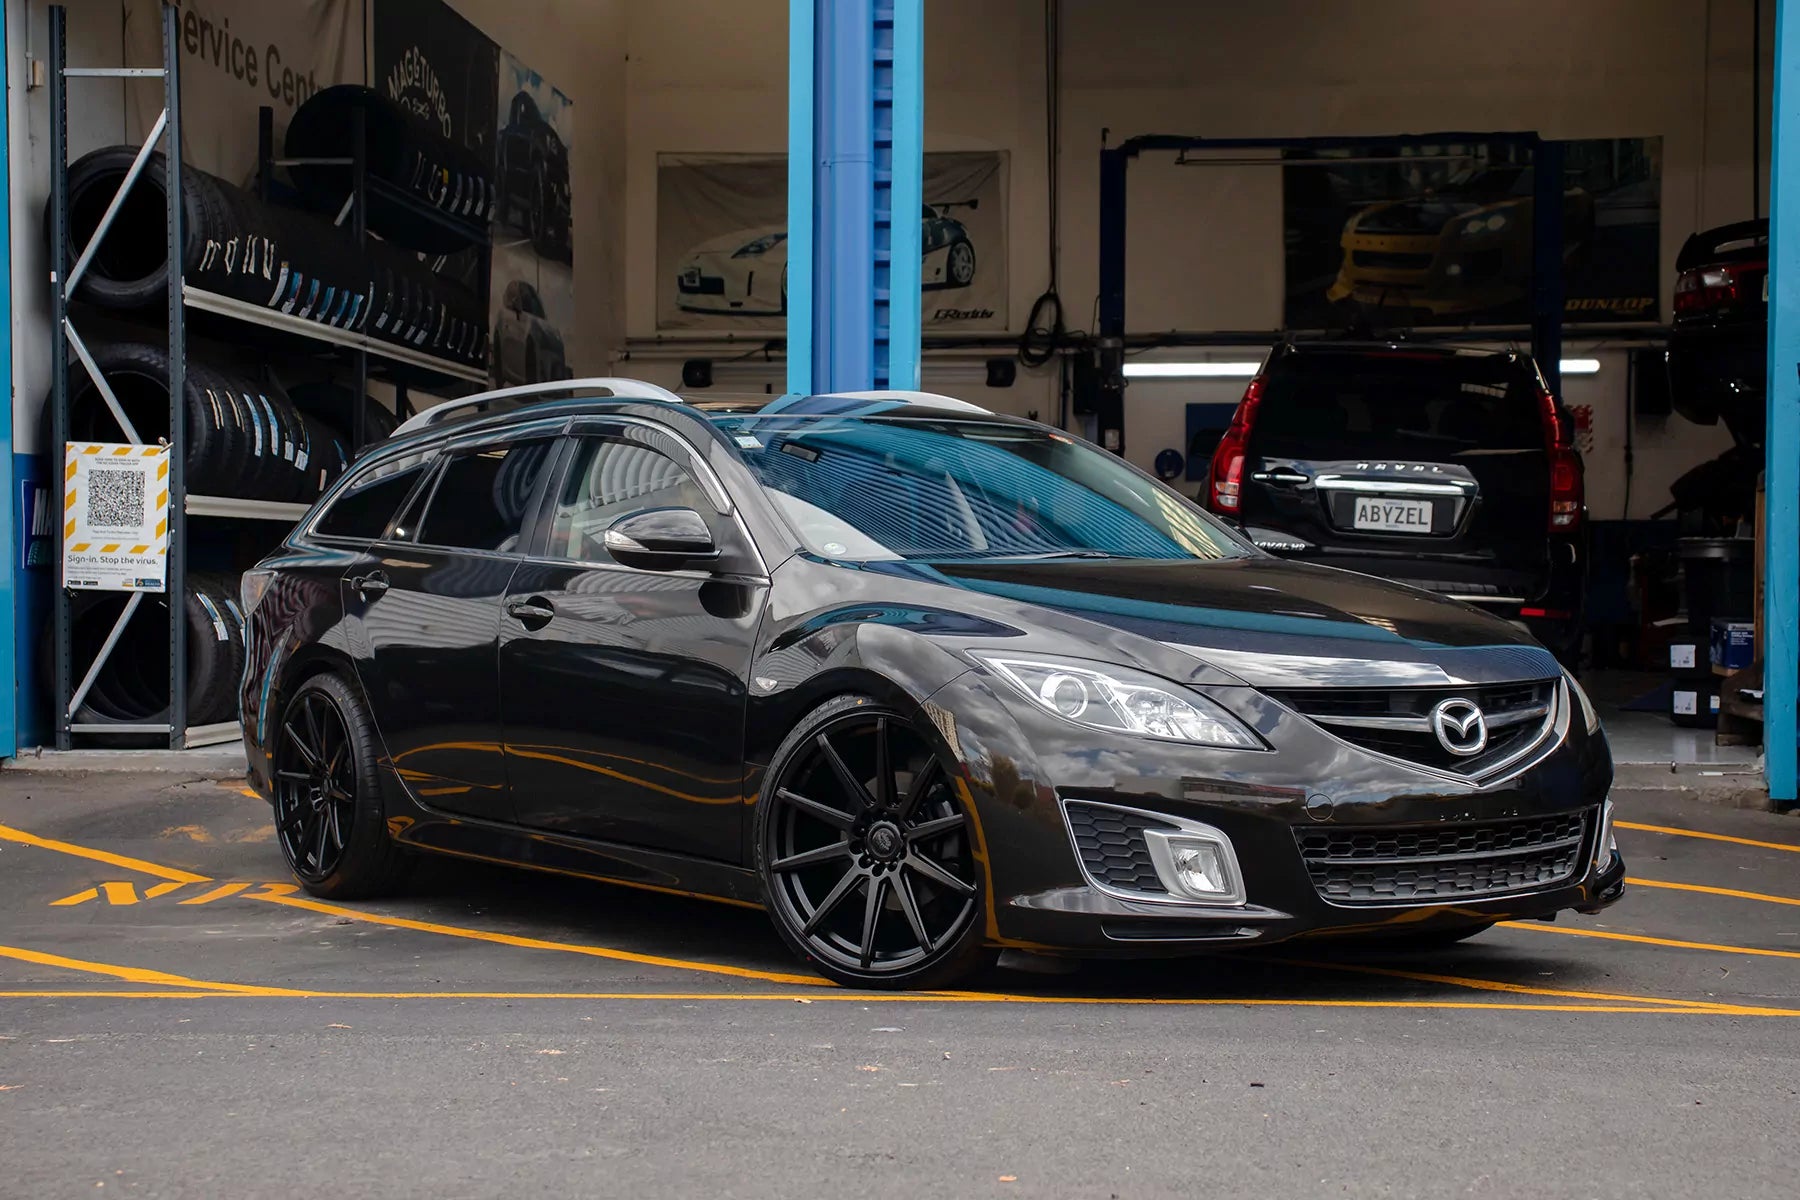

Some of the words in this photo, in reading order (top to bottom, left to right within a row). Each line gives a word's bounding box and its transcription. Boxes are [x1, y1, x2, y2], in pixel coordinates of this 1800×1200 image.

[177, 10, 258, 87] ervice
[1565, 297, 1655, 311] DUNLOP
[1358, 504, 1429, 526] ABYZEL
[67, 554, 98, 564] Sign-in.
[100, 555, 119, 565] Stop
[121, 556, 134, 565] the
[136, 556, 158, 565] virus.
